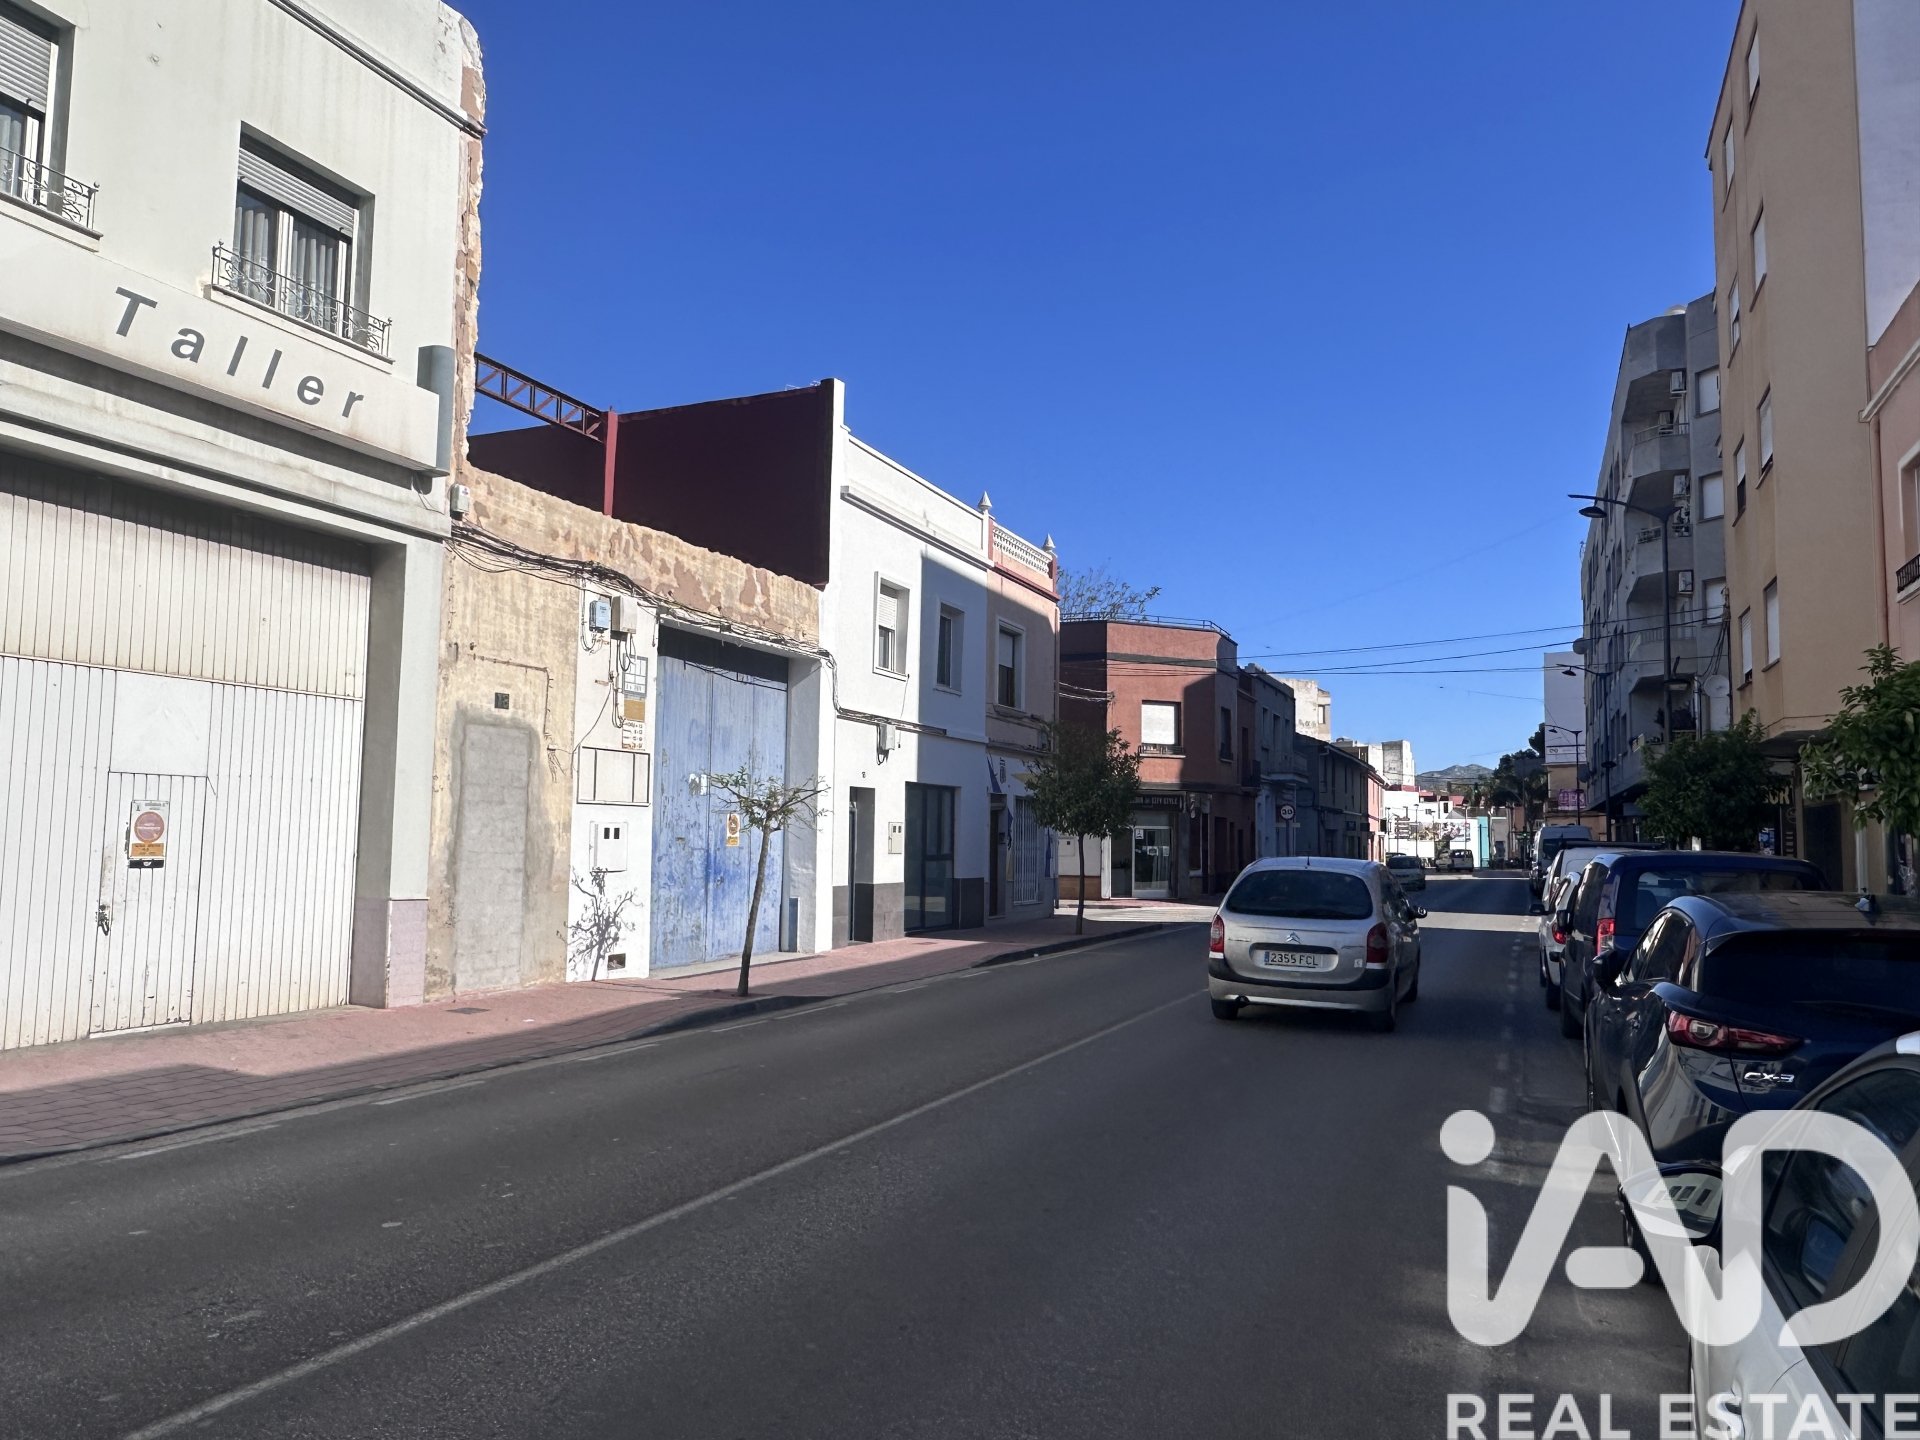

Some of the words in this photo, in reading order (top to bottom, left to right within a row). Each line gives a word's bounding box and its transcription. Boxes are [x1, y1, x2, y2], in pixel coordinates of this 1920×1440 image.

[116, 286, 364, 418] Taller
[1270, 951, 1297, 964] 2355
[1299, 954, 1319, 966] FCL
[1744, 1071, 1795, 1084] CX-3
